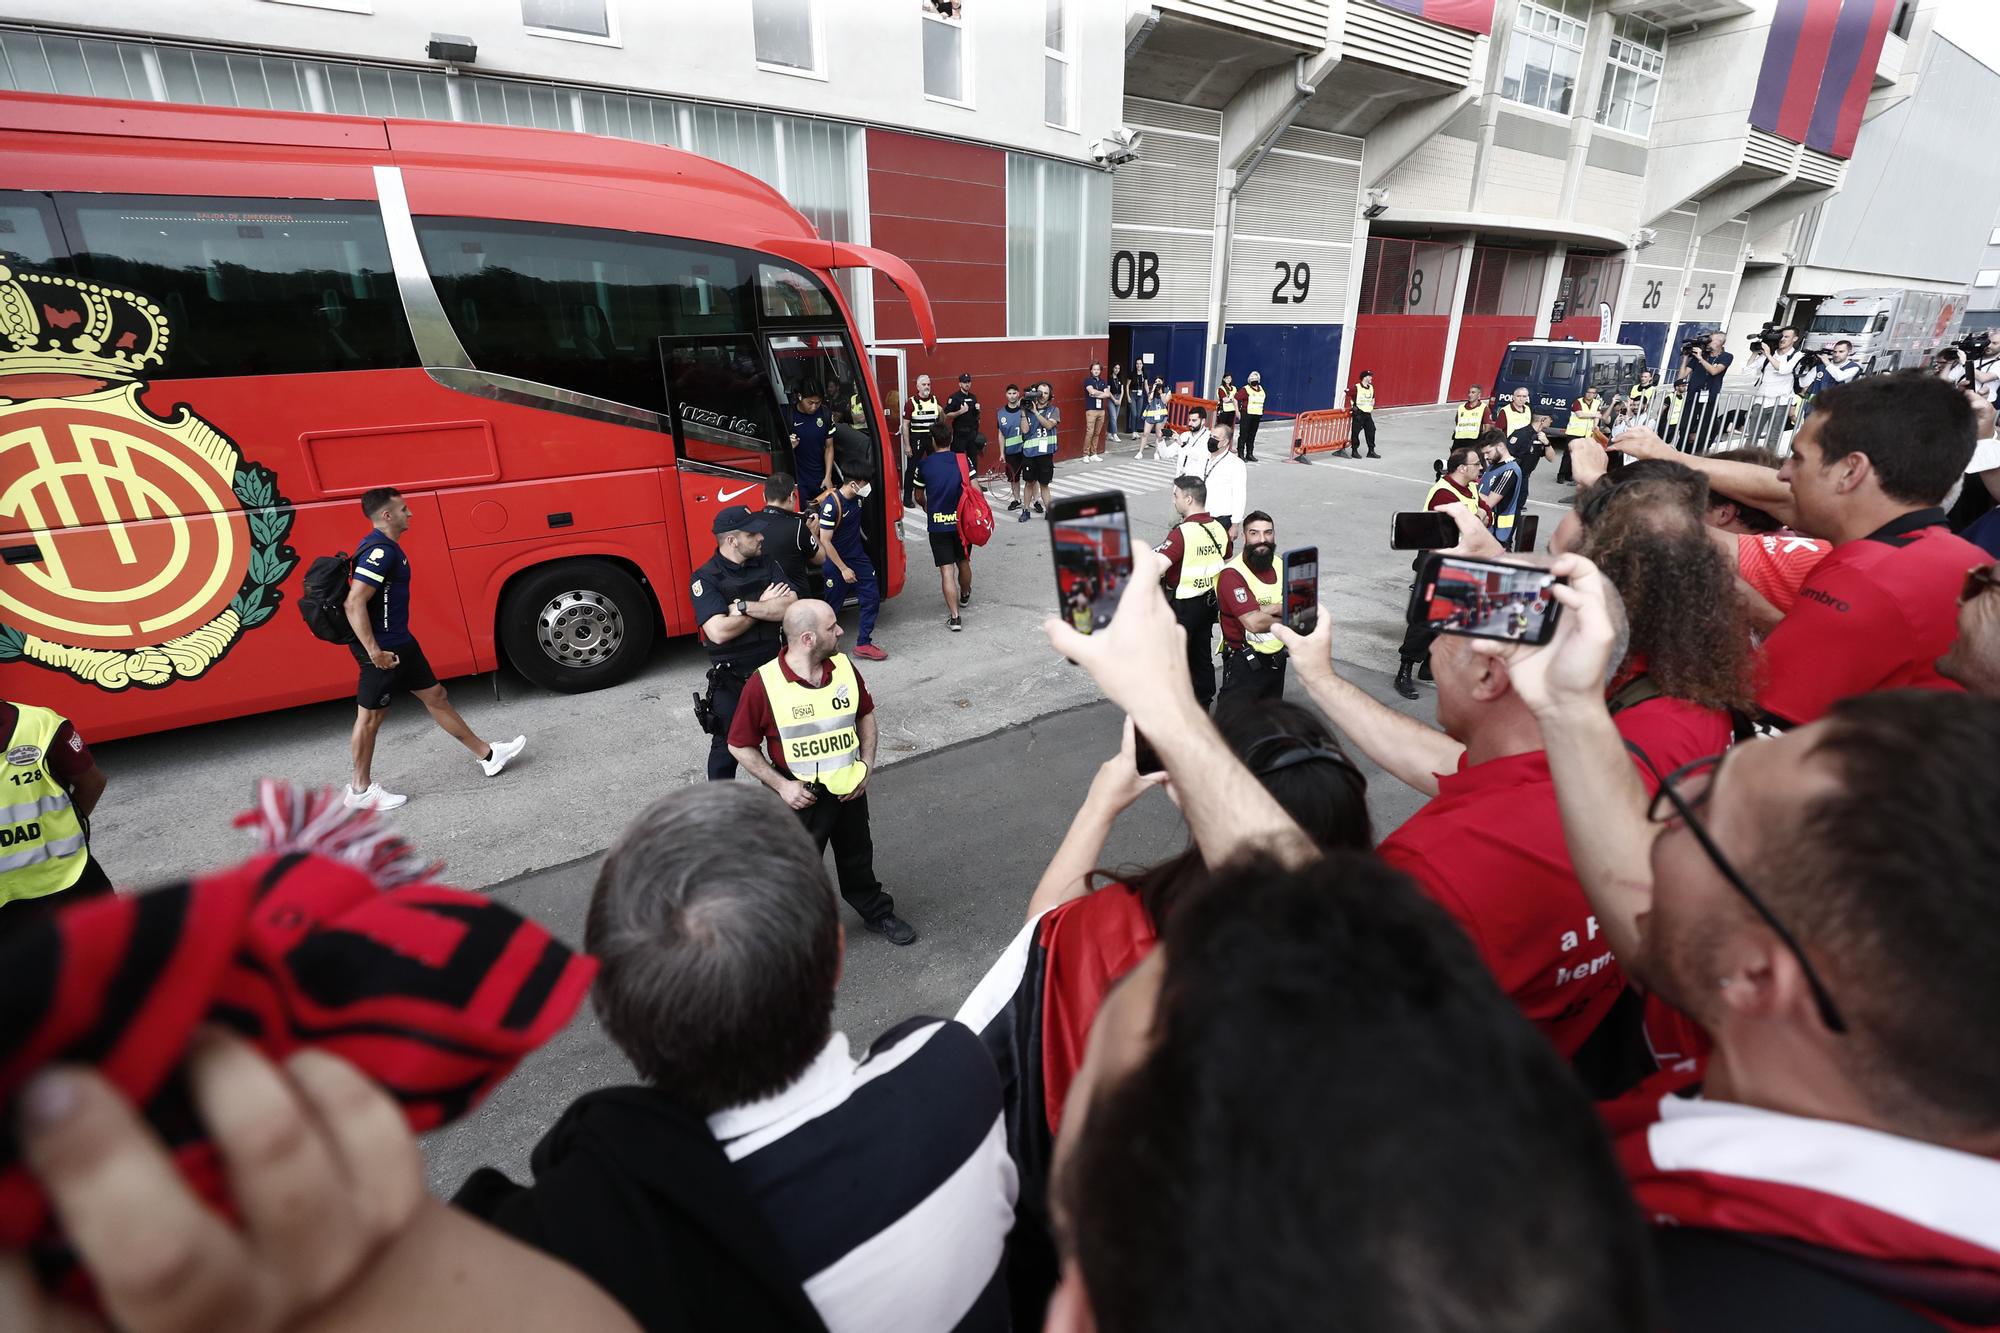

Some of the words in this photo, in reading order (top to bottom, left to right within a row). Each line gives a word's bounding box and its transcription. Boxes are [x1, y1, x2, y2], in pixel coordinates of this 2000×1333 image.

[1272, 261, 1310, 304] 29
[1642, 280, 1663, 309] 26
[1697, 283, 1716, 310] 25
[1540, 397, 1566, 407] 6U-25
[1036, 428, 1047, 438] 33
[794, 706, 813, 718] PSNA
[832, 697, 850, 710] 09
[10, 768, 43, 786] 128
[1561, 930, 1578, 952] a
